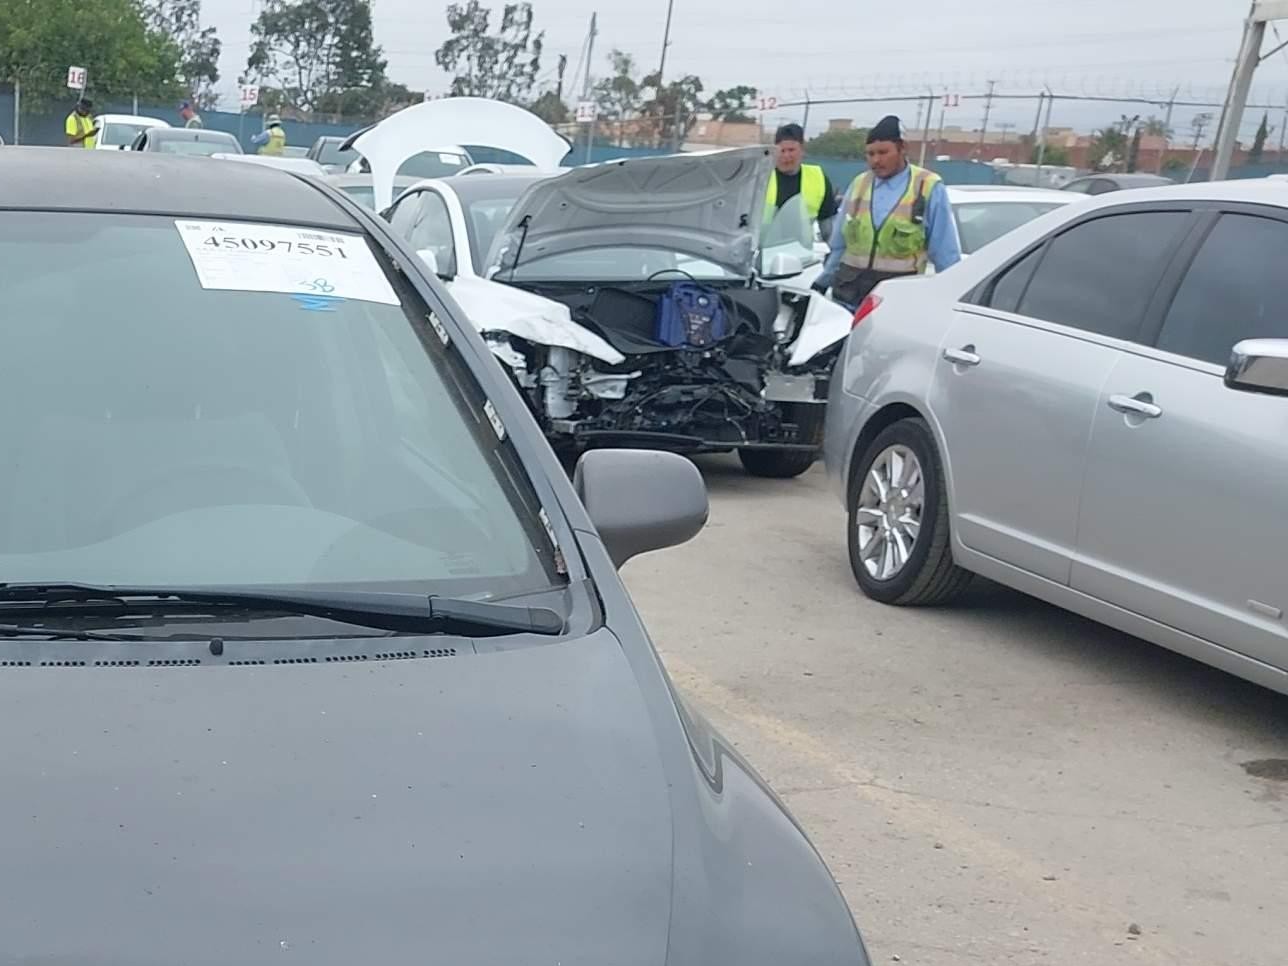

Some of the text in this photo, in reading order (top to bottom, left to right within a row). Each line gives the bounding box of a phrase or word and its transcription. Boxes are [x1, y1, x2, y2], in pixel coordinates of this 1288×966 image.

[242, 88, 256, 101] 15
[943, 94, 959, 107] 11
[759, 97, 777, 111] 12
[203, 236, 348, 259] 45097551
